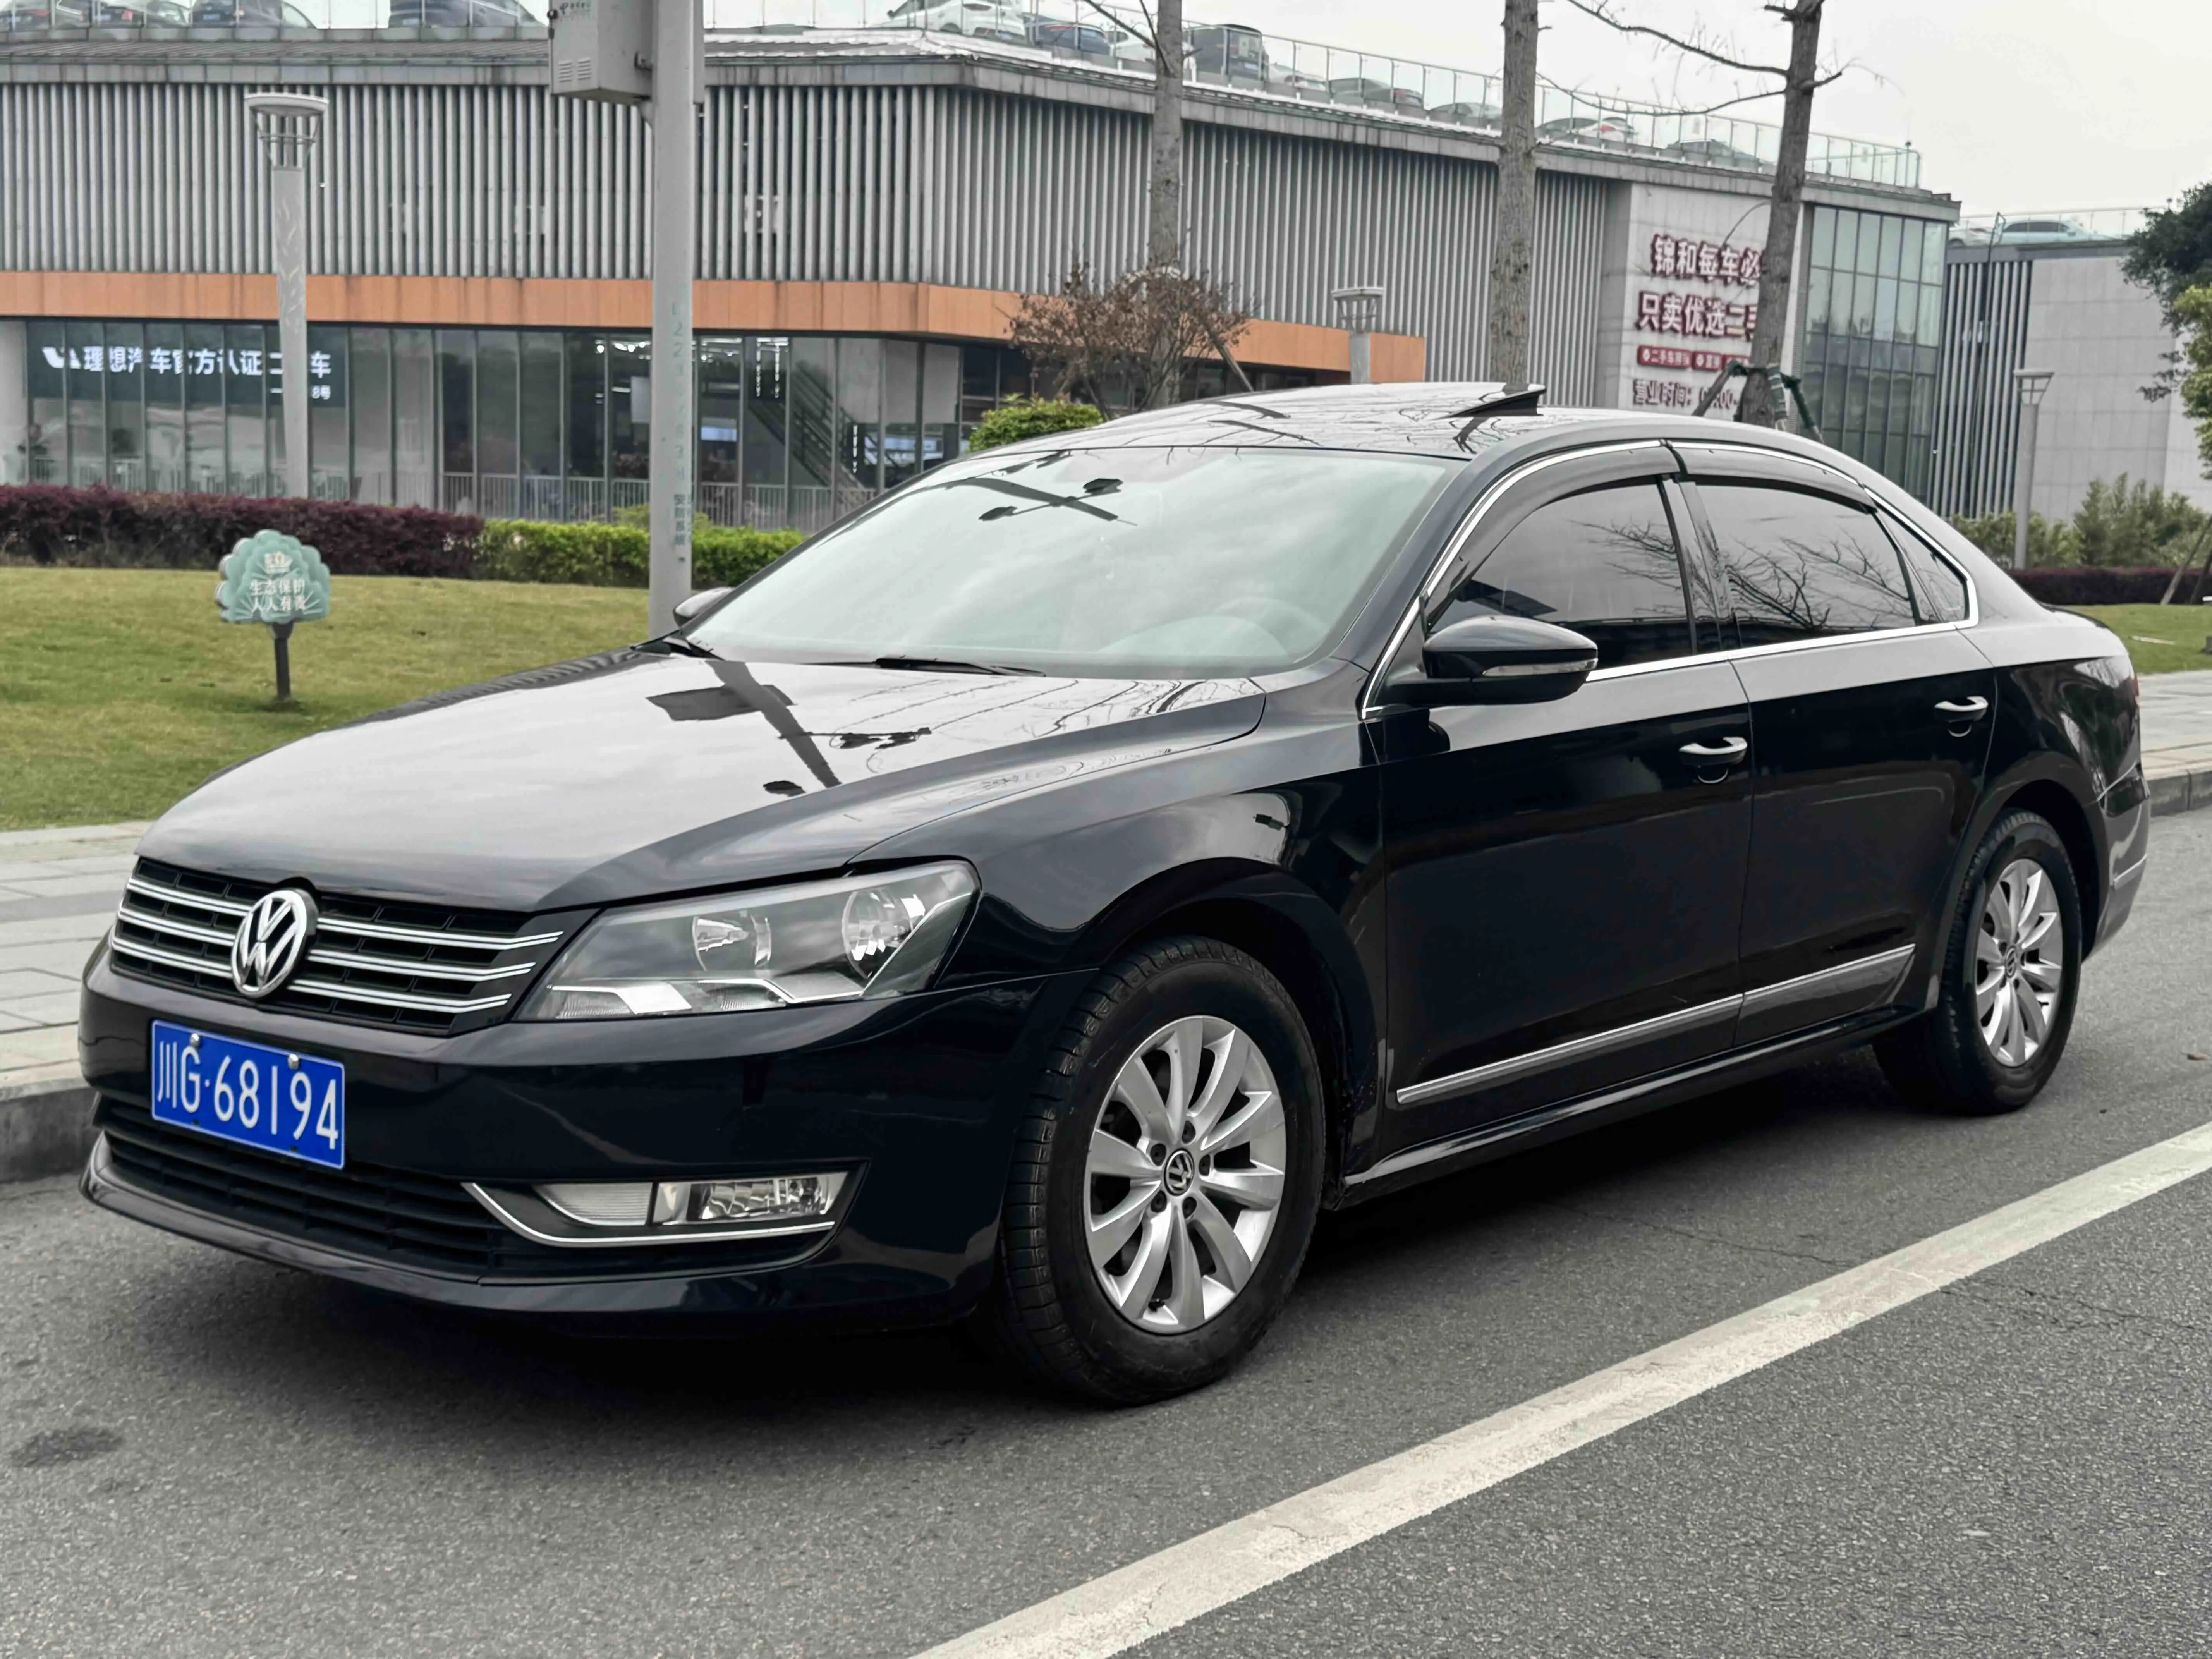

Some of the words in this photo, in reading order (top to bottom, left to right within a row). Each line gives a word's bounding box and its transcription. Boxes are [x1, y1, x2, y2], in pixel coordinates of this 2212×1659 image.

[83, 346, 331, 378] 理想汽车官方认证二车
[157, 1041, 338, 1150] 川G·68194
